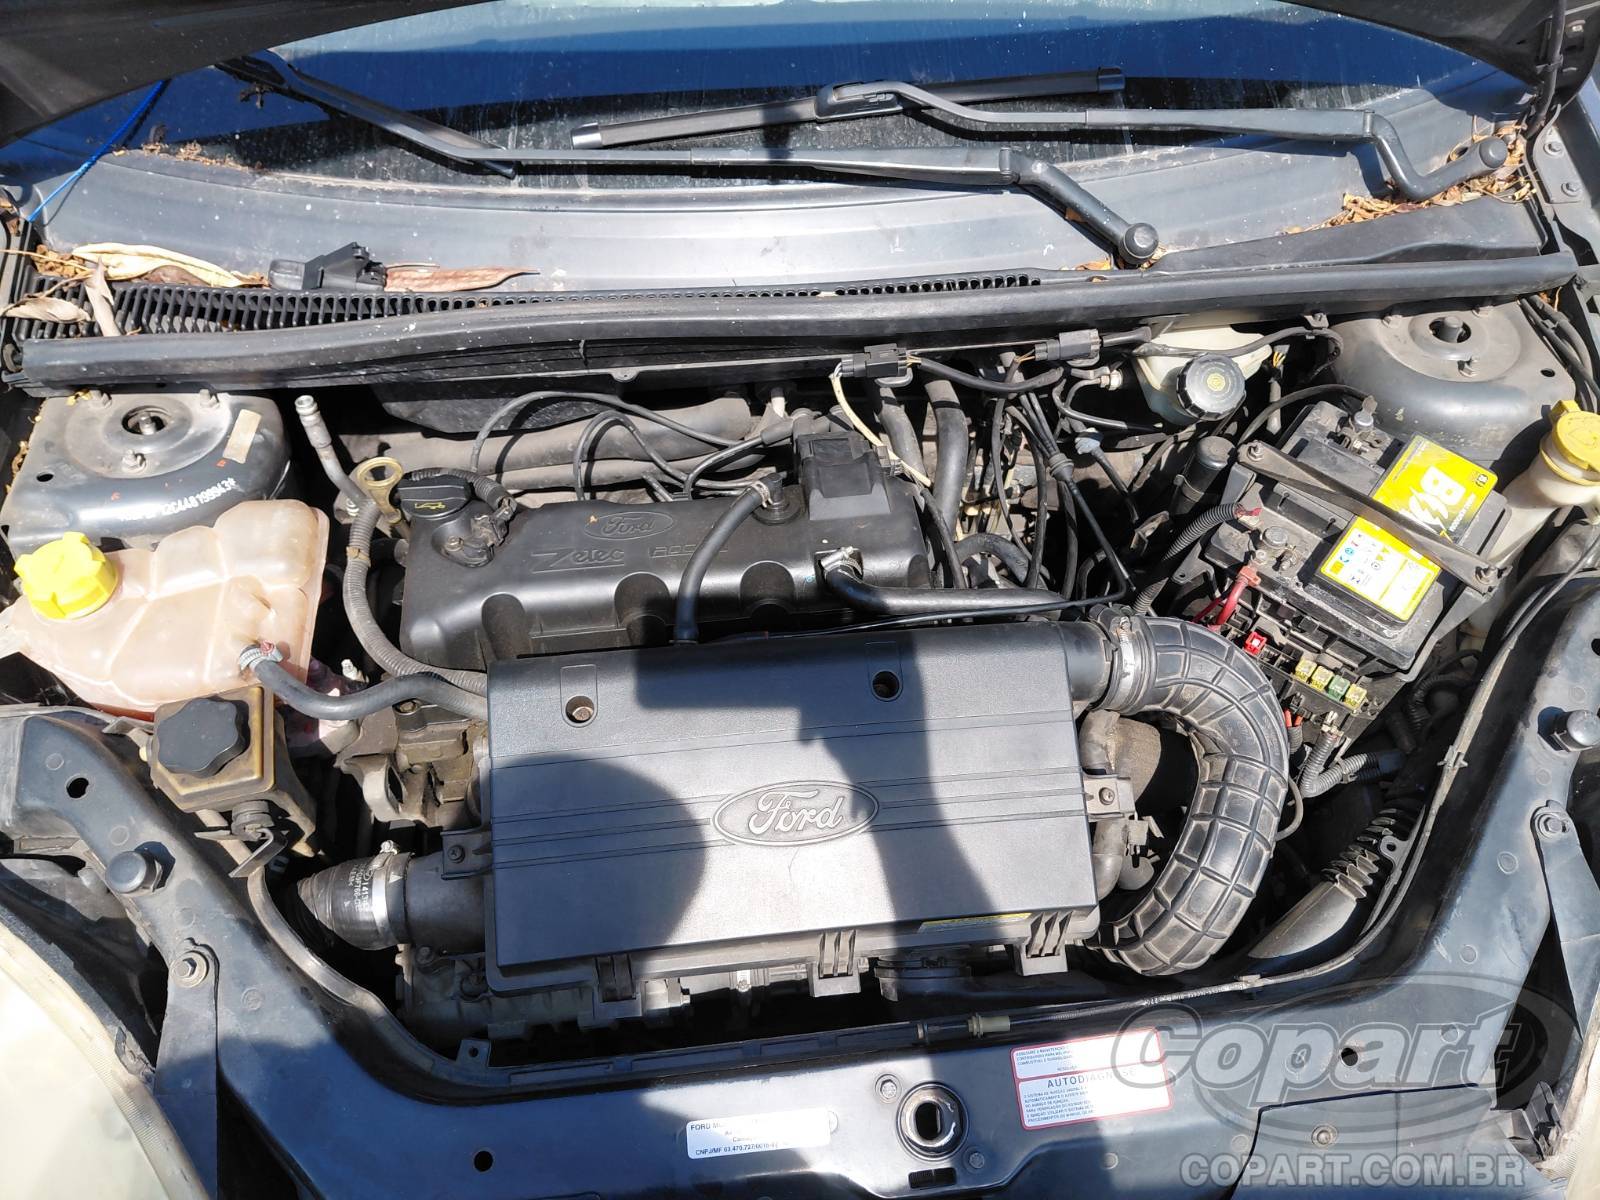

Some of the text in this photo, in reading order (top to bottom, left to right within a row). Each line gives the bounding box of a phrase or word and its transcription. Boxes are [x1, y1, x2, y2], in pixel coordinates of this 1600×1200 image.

[601, 517, 657, 536] Ford
[530, 548, 625, 574] Zetec
[748, 789, 846, 836] Ford
